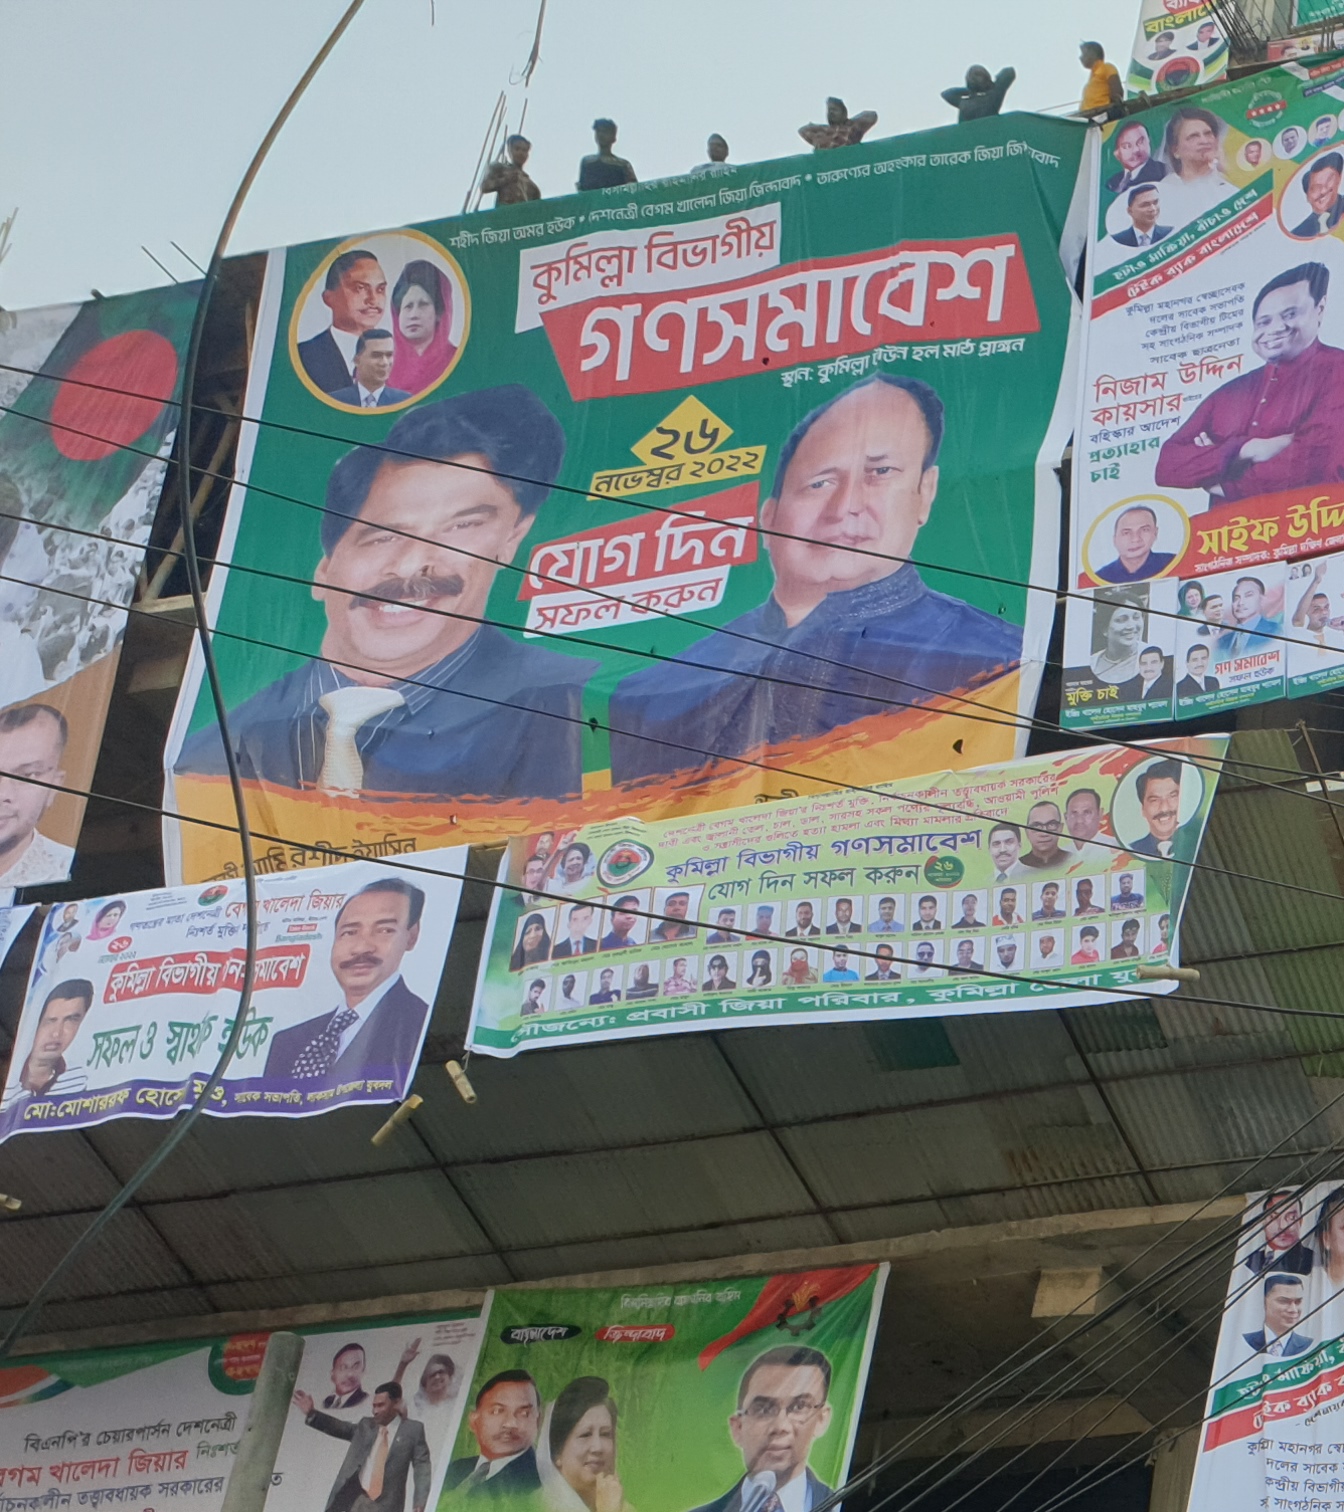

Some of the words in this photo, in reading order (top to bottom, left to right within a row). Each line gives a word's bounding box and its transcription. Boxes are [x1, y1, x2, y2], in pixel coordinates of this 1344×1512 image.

[530, 243, 636, 305] কুমিল্লা
[645, 217, 778, 274] বিভাগীয়
[580, 244, 1015, 381] গণসমাবেশ
[1093, 369, 1167, 403] নিজাম
[1178, 354, 1245, 387] উদ্দিন
[1091, 392, 1183, 427] কায়সার
[650, 416, 723, 462] ২৬
[593, 454, 685, 498] নভেম্বর
[689, 445, 761, 483] ২০২২
[1089, 464, 1121, 483] চাই
[528, 526, 656, 593] যোগ
[654, 498, 756, 569] দিন
[1197, 513, 1279, 556] সাইফ
[533, 588, 620, 634] সফল
[627, 574, 722, 627] করুন
